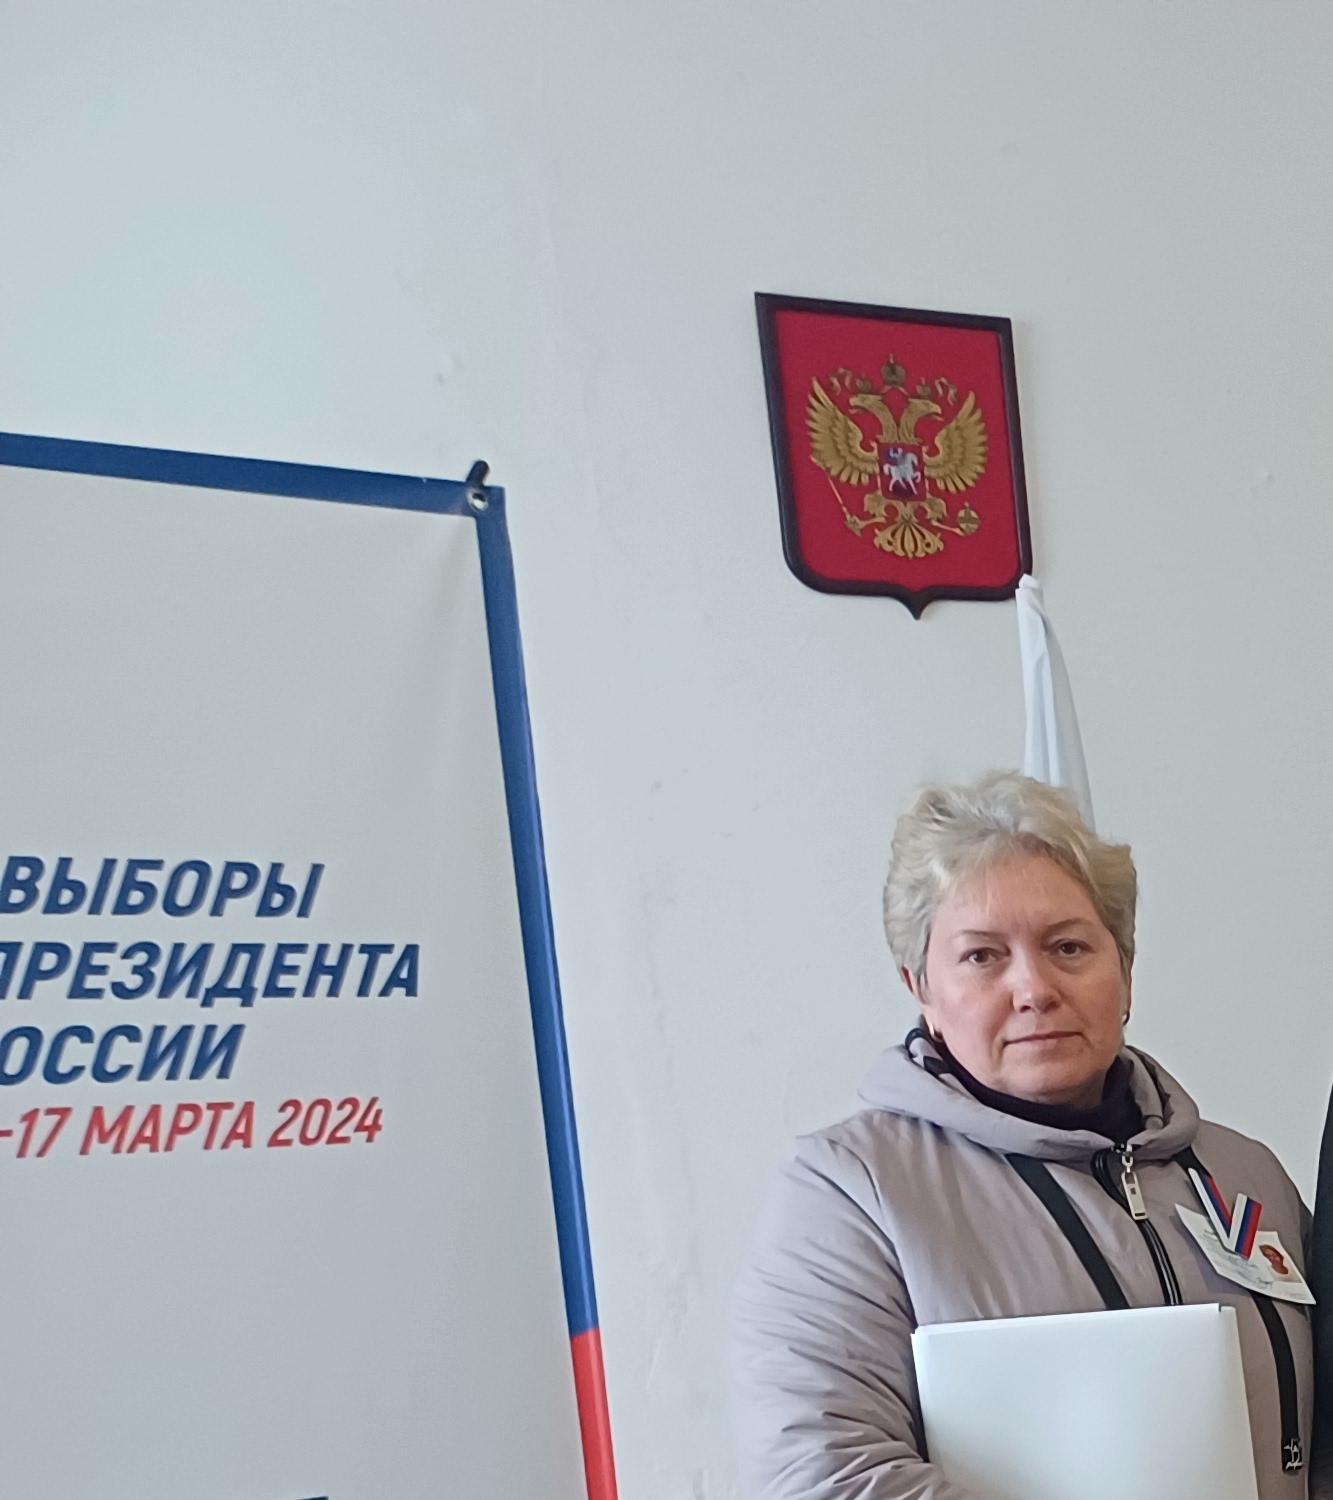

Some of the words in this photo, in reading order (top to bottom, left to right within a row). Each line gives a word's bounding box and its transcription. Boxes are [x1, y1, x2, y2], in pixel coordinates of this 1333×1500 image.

[0, 855, 325, 918] ВЫБОРЫ
[0, 1024, 246, 1086] ОССИИ
[79, 1101, 256, 1156] МАРТА
[267, 1096, 384, 1149] 2024
